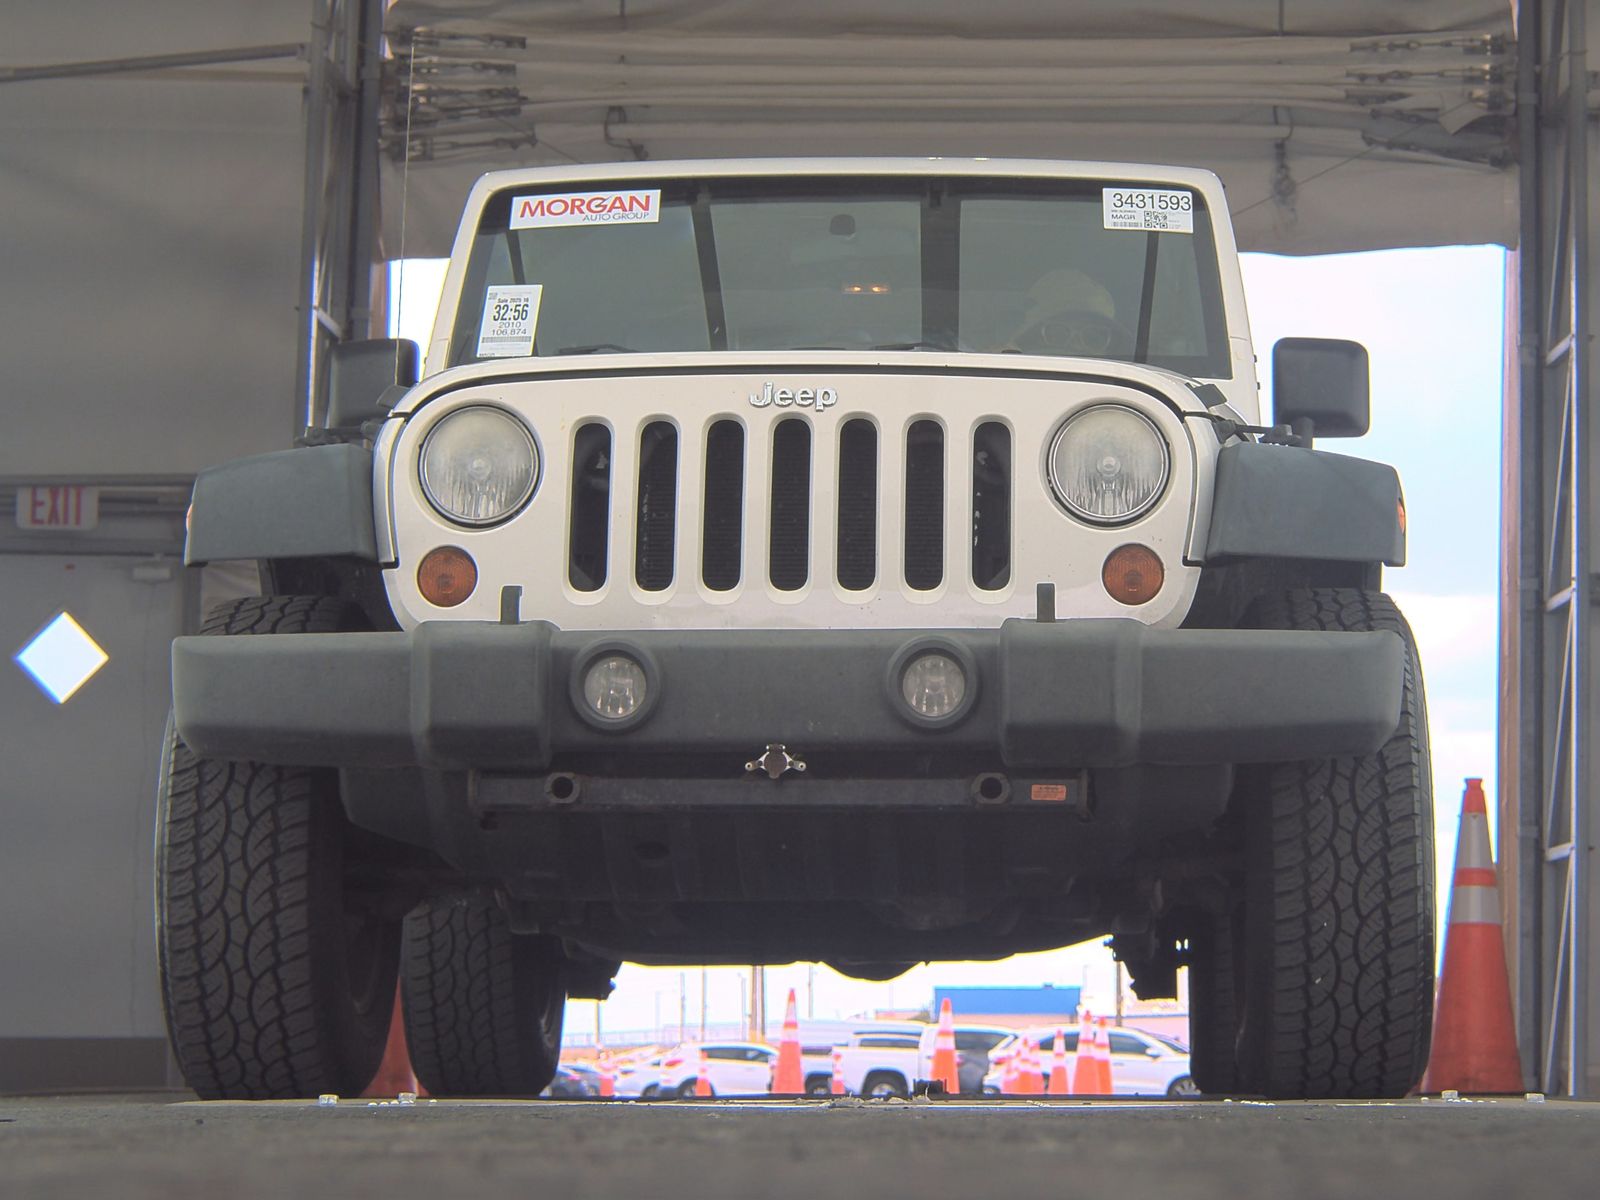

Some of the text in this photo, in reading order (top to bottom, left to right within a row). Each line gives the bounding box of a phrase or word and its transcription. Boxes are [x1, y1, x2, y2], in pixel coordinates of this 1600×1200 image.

[519, 194, 651, 218] MORGAN
[1112, 192, 1192, 211] 3431593
[582, 212, 650, 222] AUTO GROUP
[493, 303, 529, 321] 32:56
[498, 321, 522, 329] 2010
[749, 381, 838, 412] Jeep
[31, 484, 86, 526] EXIT
